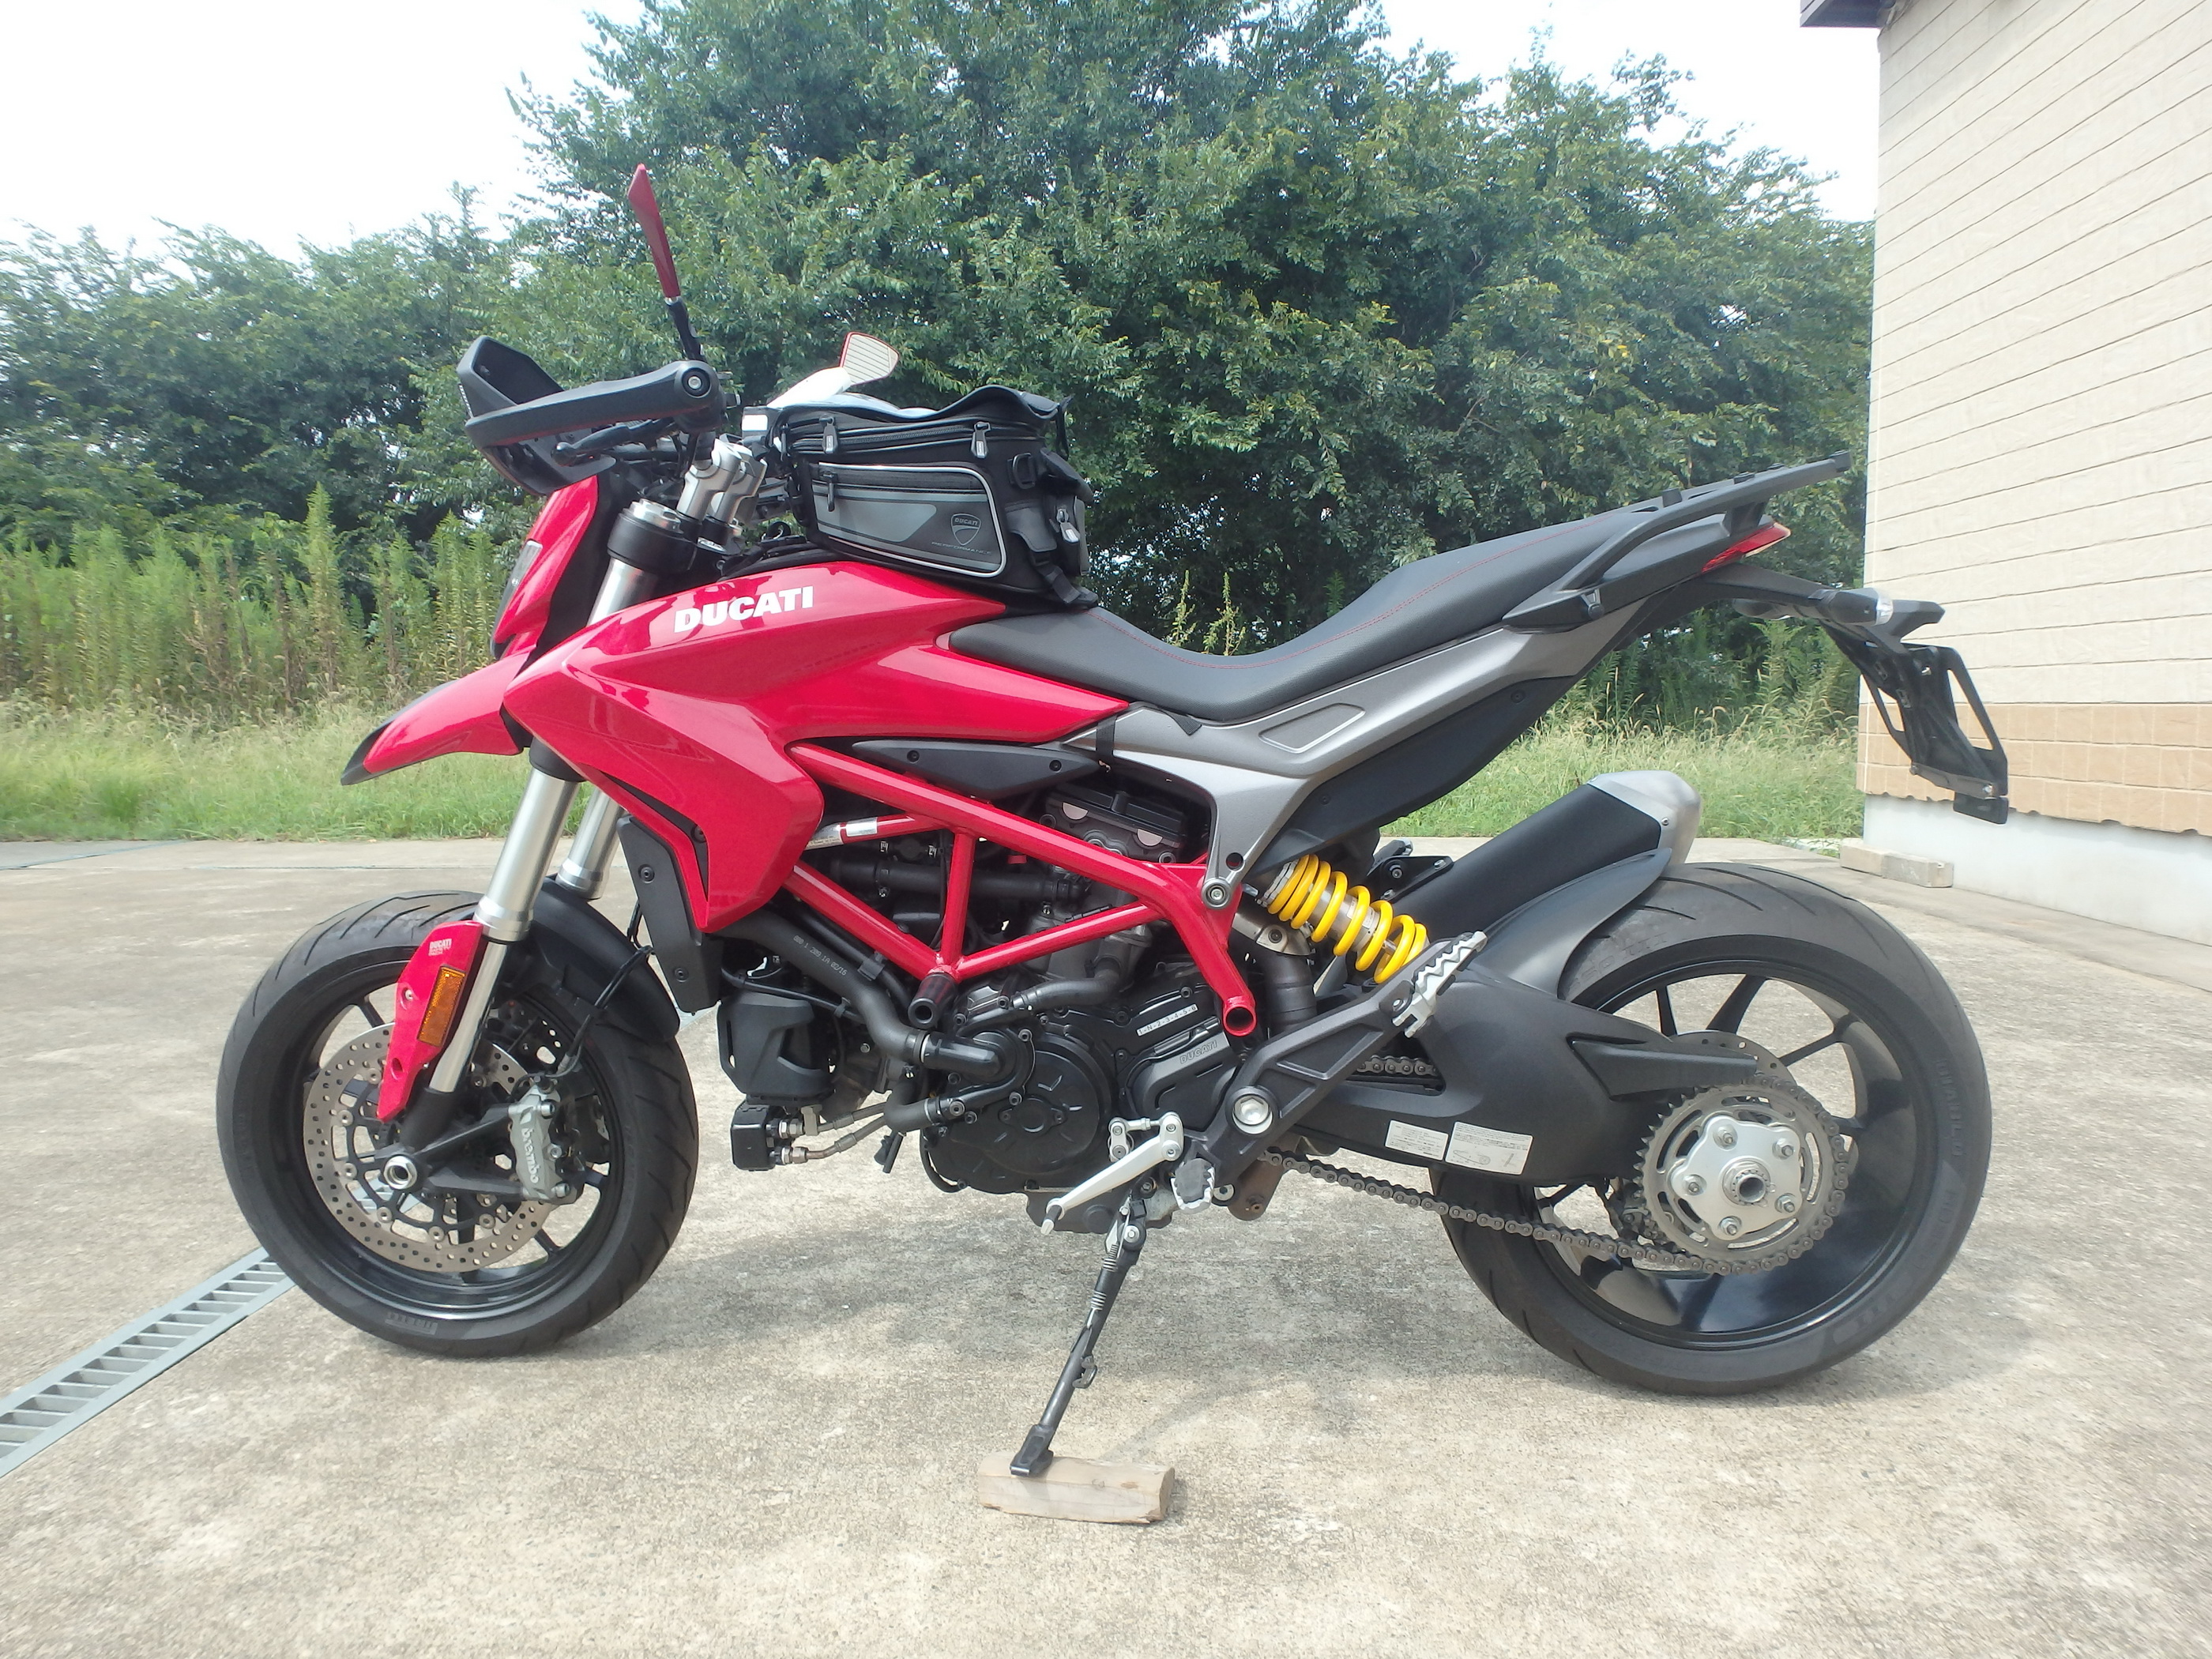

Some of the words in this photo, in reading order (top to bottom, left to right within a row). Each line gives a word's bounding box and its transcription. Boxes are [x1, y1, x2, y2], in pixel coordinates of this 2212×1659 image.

[954, 517, 979, 526] DUCATI
[931, 541, 992, 555] PERFORMANCE
[674, 585, 814, 633] DUCATI
[830, 961, 848, 976] 02/16
[1179, 1040, 1217, 1065] DUCATI
[521, 1127, 541, 1183] brembo
